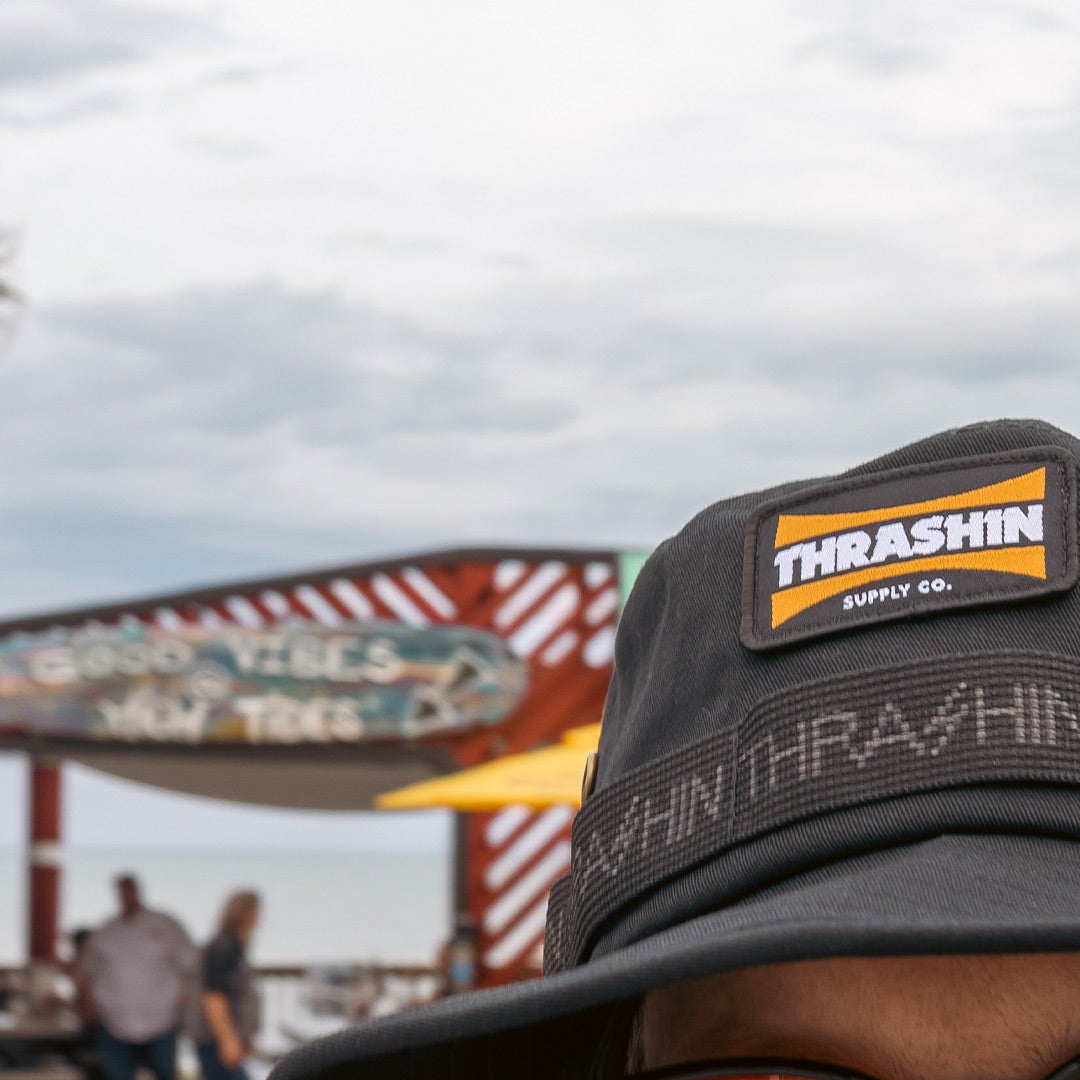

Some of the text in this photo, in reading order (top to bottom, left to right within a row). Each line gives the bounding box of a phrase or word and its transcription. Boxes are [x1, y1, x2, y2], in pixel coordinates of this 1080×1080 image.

[774, 504, 1044, 588] THRASHIN
[842, 577, 953, 611] SUPPLY CO.
[227, 634, 404, 684] VIBES
